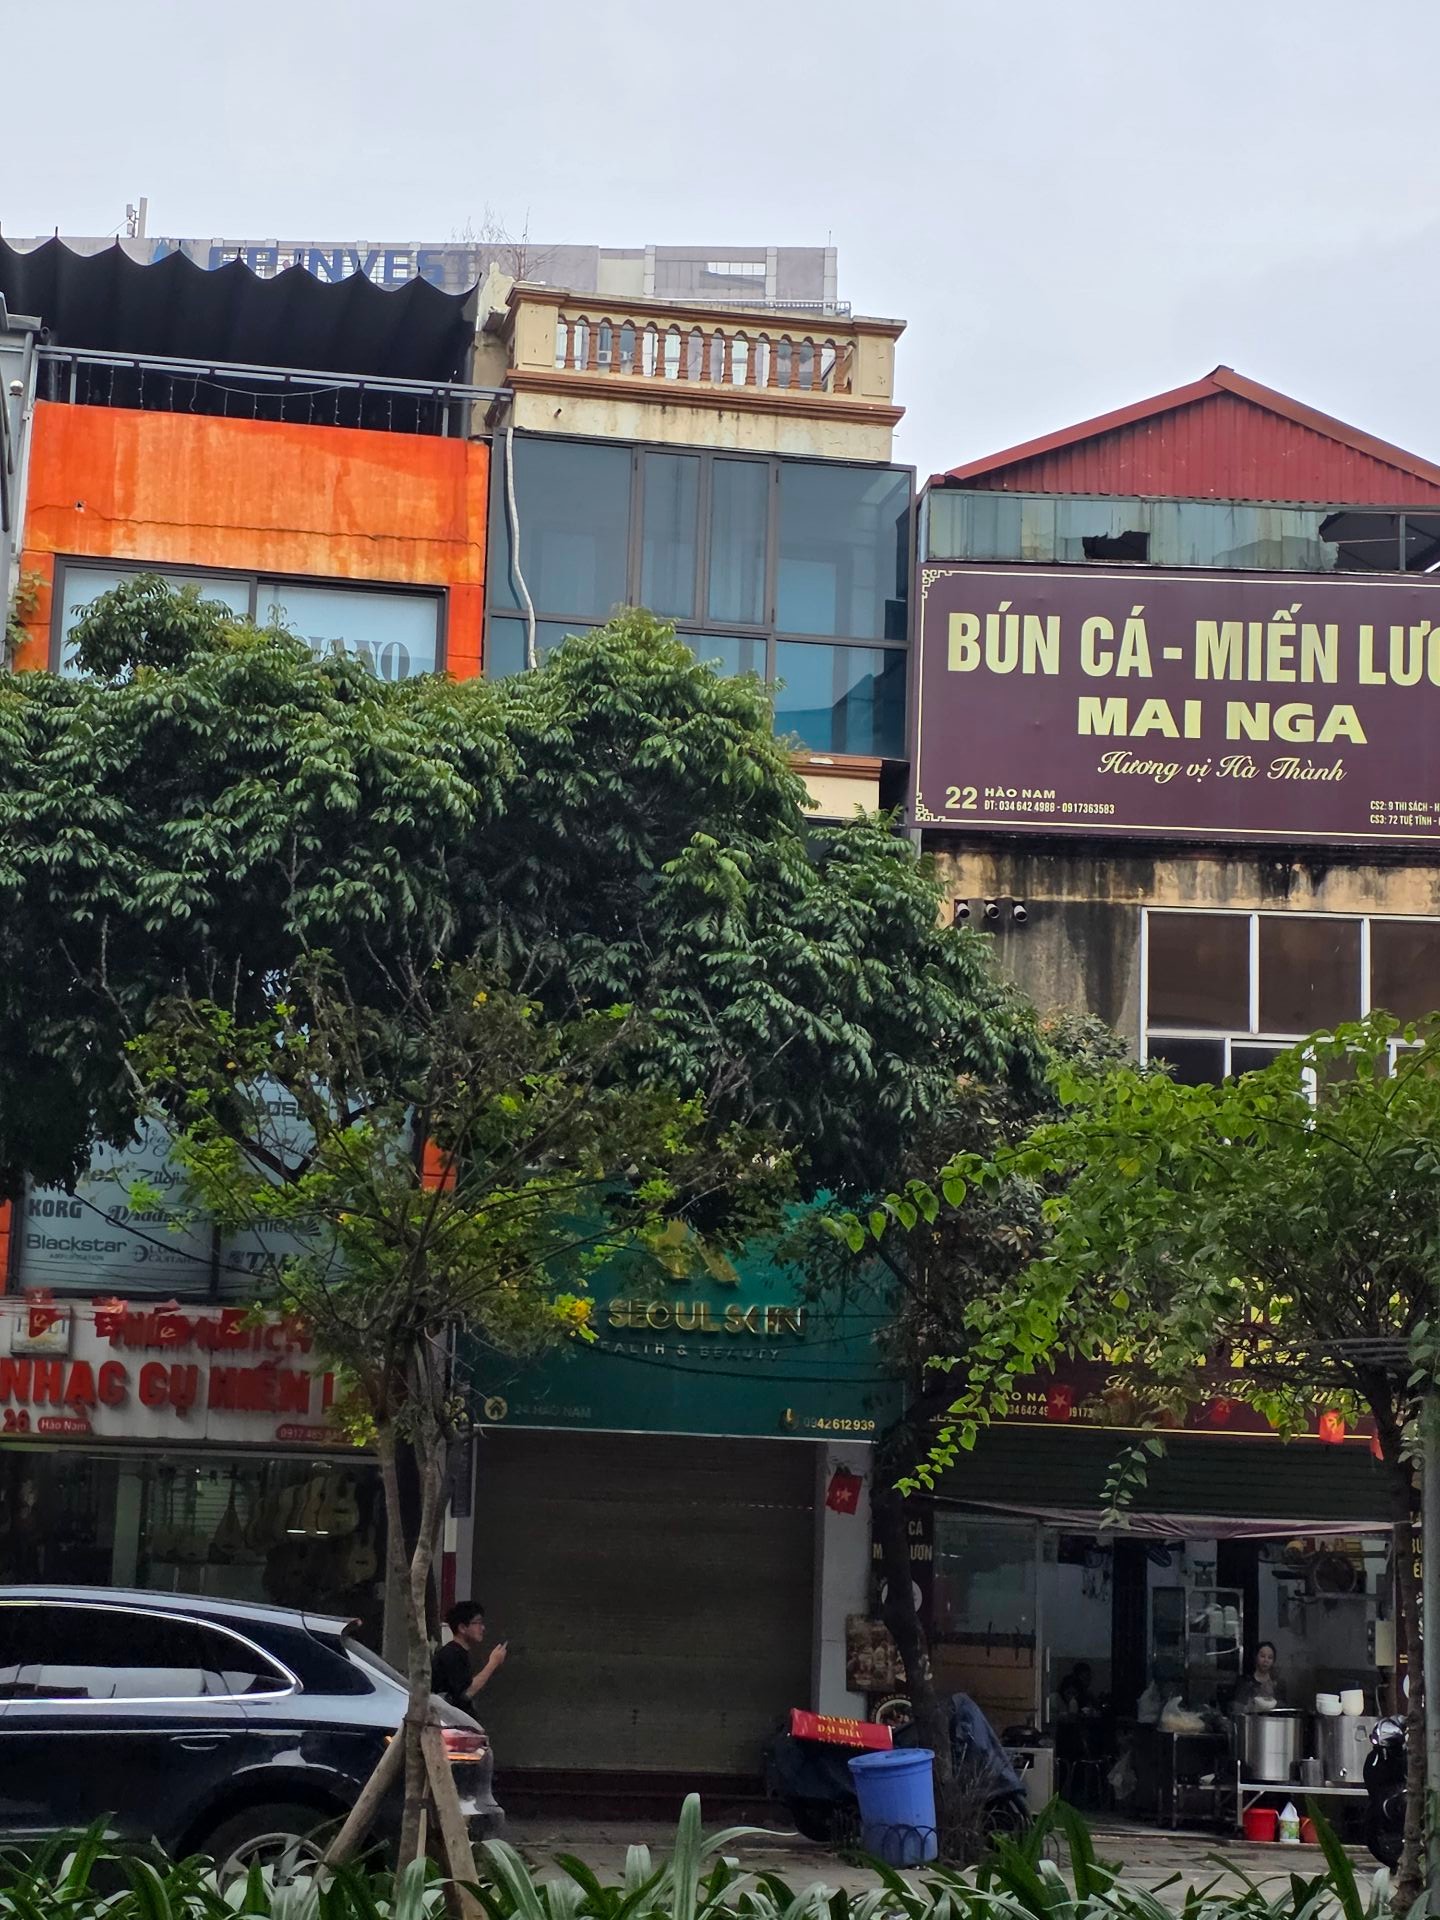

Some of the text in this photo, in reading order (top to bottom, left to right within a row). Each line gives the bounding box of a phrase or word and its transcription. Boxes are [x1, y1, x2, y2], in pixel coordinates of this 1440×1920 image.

[948, 601, 1060, 675] BÚN
[1080, 605, 1153, 678] CÁ
[1163, 647, 1183, 660] -
[1195, 603, 1338, 684] MIẾN
[1078, 697, 1368, 744] MAI NGA
[1097, 751, 1347, 784] Hương vị Hà Thành
[944, 786, 978, 810] 22
[984, 786, 1056, 800] HÀO NAM
[999, 800, 1015, 811] 034
[1016, 801, 1033, 812] 642
[1370, 800, 1387, 811] CS2:
[1388, 801, 1394, 811] 9
[1408, 800, 1428, 812] SÁCH
[1370, 814, 1387, 825] CS3:
[1388, 815, 1398, 825] 72
[28, 1198, 84, 1219] KORG
[26, 1233, 127, 1253] Blackstar
[607, 1299, 721, 1331] SEOUL
[600, 1341, 666, 1355] EALTH
[676, 1343, 689, 1356] &
[0, 1356, 127, 1416] NHẠC
[1027, 1391, 1048, 1402] NA
[3, 1408, 87, 1433] 26 Hào Nam
